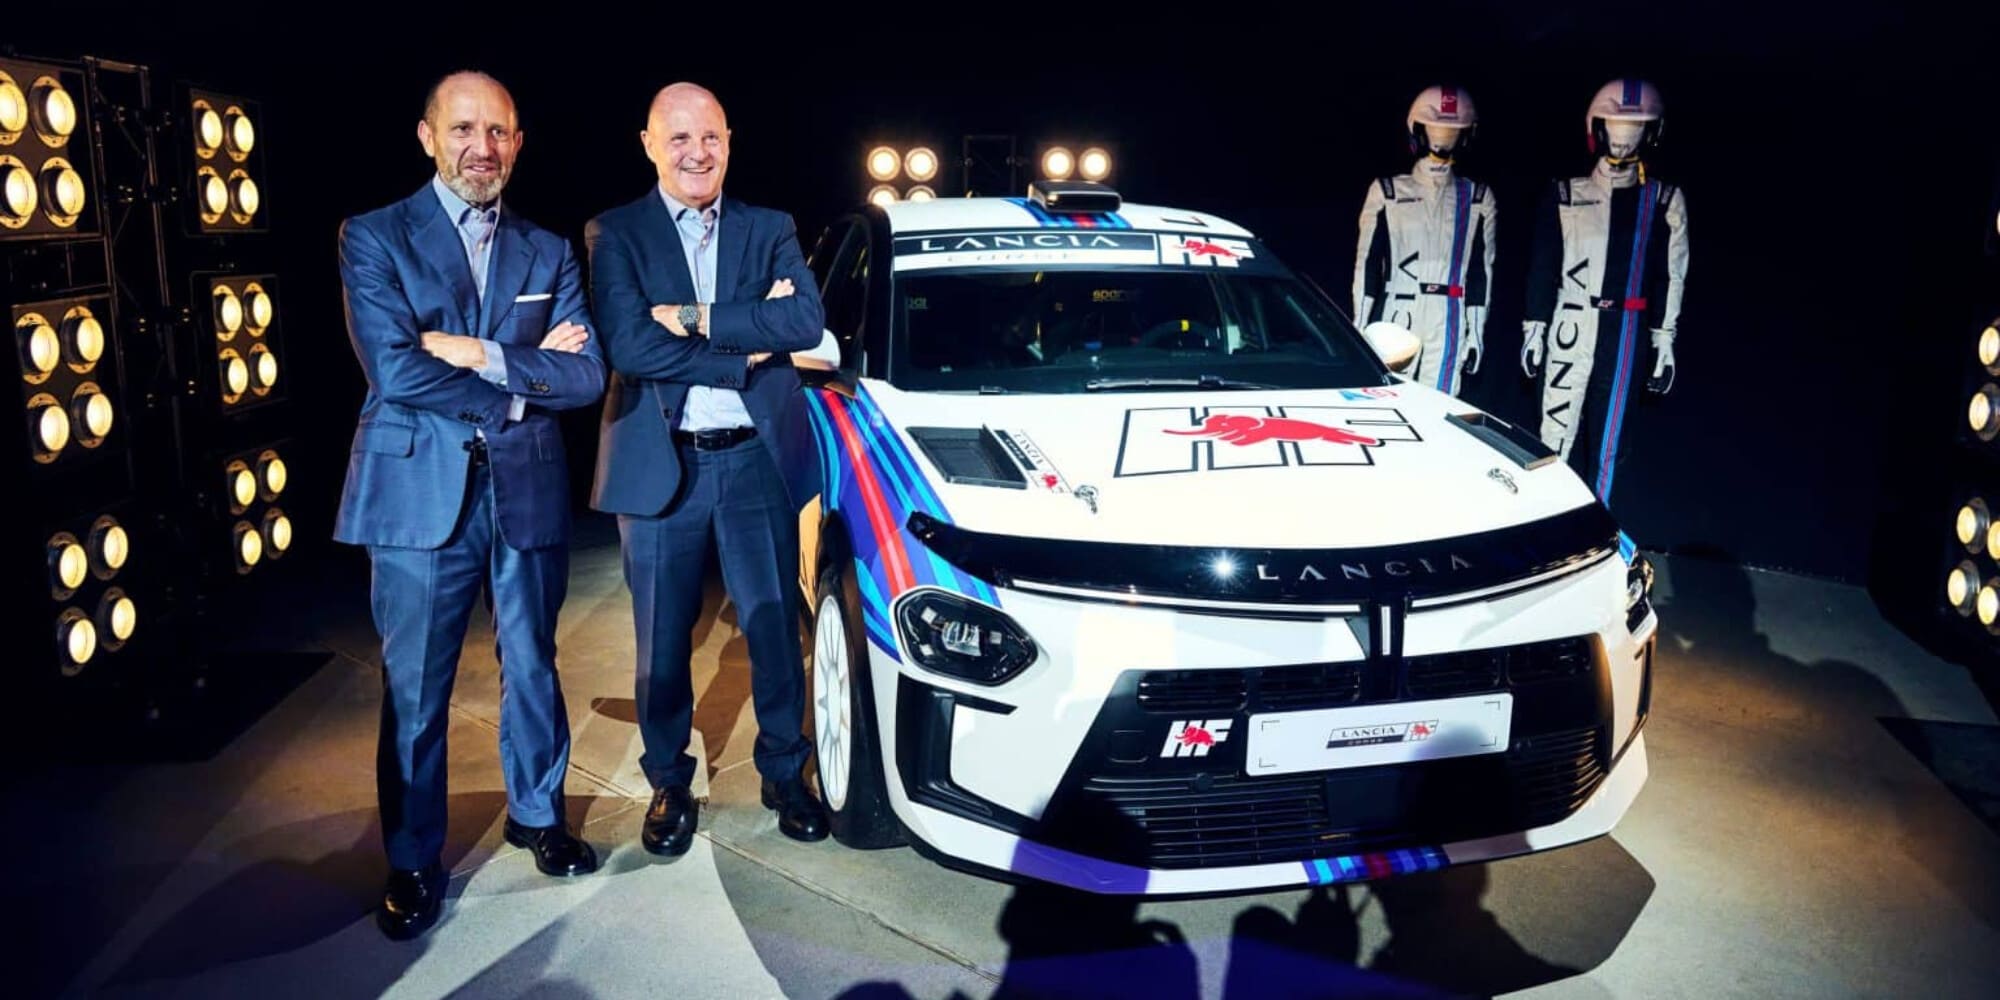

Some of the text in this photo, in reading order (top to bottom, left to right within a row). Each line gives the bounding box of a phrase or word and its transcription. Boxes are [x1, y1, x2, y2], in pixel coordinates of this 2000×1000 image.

[920, 234, 1118, 251] LANCIA
[1257, 553, 1472, 581] LANCIA
[1341, 726, 1396, 738] LANCIA
